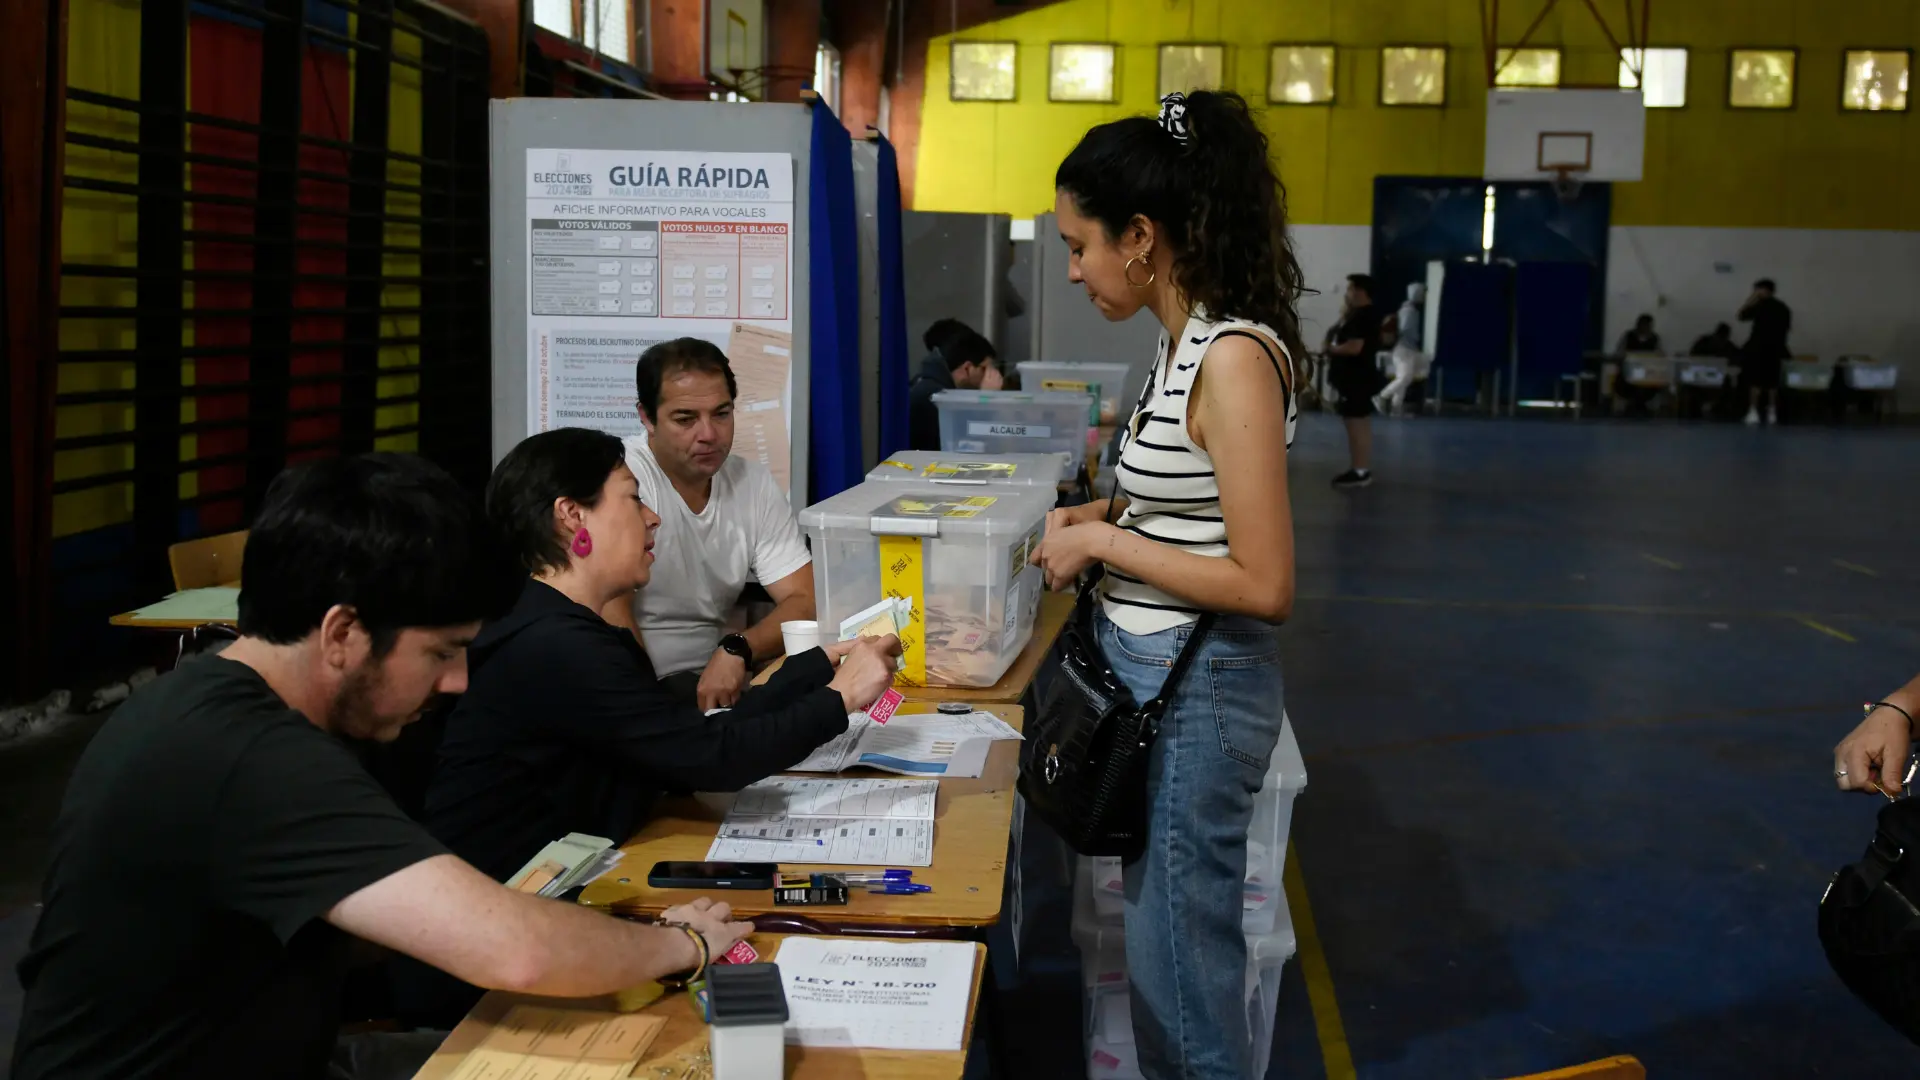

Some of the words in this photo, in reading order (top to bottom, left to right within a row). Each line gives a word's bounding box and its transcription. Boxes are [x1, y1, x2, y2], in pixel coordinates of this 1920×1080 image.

[534, 172, 592, 184] ELECCIONES
[609, 162, 670, 187] GUÍA
[678, 162, 770, 189] RÁPIDA
[545, 184, 572, 196] 2024
[609, 187, 632, 197] PARA
[633, 188, 656, 198] MESA
[658, 188, 707, 198] RECEPTORA
[709, 189, 721, 199] DE
[722, 189, 770, 200] SUFRAGIOS
[553, 204, 594, 215] AFICHE
[598, 205, 675, 216] INFORMATIVO
[676, 206, 710, 217] PARA
[712, 206, 766, 218] VOCALES
[558, 220, 595, 230] VOTOS
[597, 220, 632, 231] VÁLIDOS
[663, 223, 694, 233] VOTOS
[695, 223, 726, 233] NULOS
[728, 224, 734, 233] Y
[735, 224, 747, 234] EN
[749, 224, 786, 234] BLANCO
[555, 337, 587, 346] PROCESOS
[587, 338, 599, 346] DEL
[599, 338, 634, 347] ESCRUTINIO
[556, 410, 596, 418] TERMINADO
[989, 425, 1027, 435] ALCALDE
[879, 697, 895, 714] VEL
[873, 708, 890, 722] SER
[852, 955, 928, 963] ELECCIONES
[794, 975, 835, 985] LEY
[872, 981, 937, 989] 18.700
